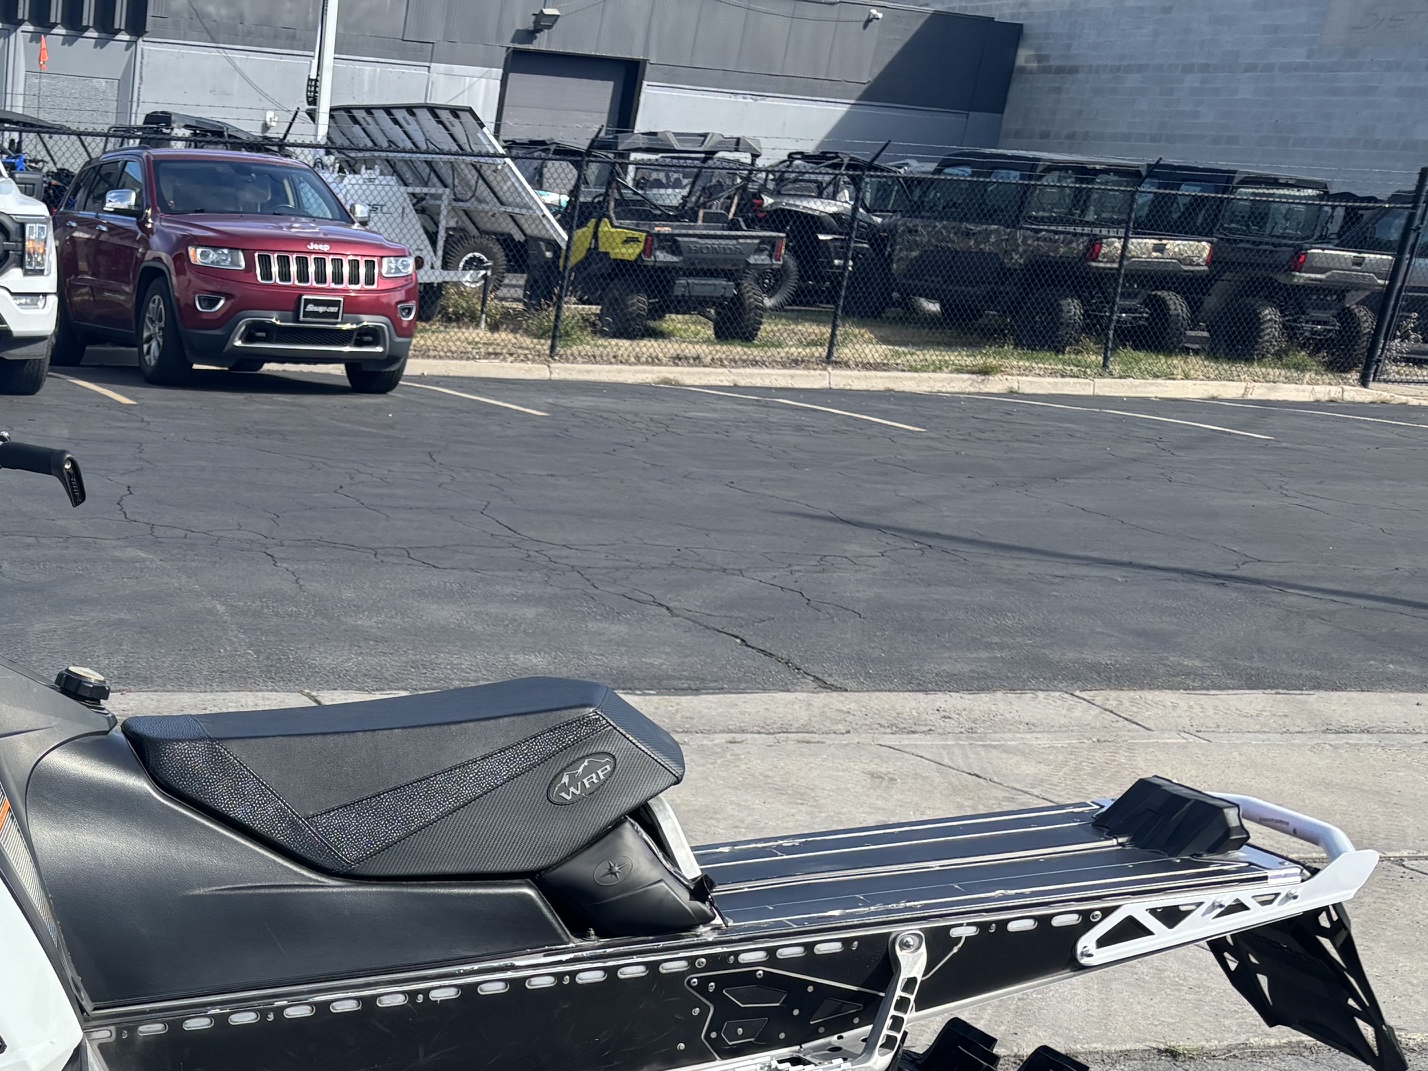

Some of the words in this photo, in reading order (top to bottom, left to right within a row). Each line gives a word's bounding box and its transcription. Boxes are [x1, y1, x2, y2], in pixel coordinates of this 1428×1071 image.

[306, 242, 330, 252] Jeep
[688, 244, 744, 255] HONDA
[558, 764, 612, 801] WRP
